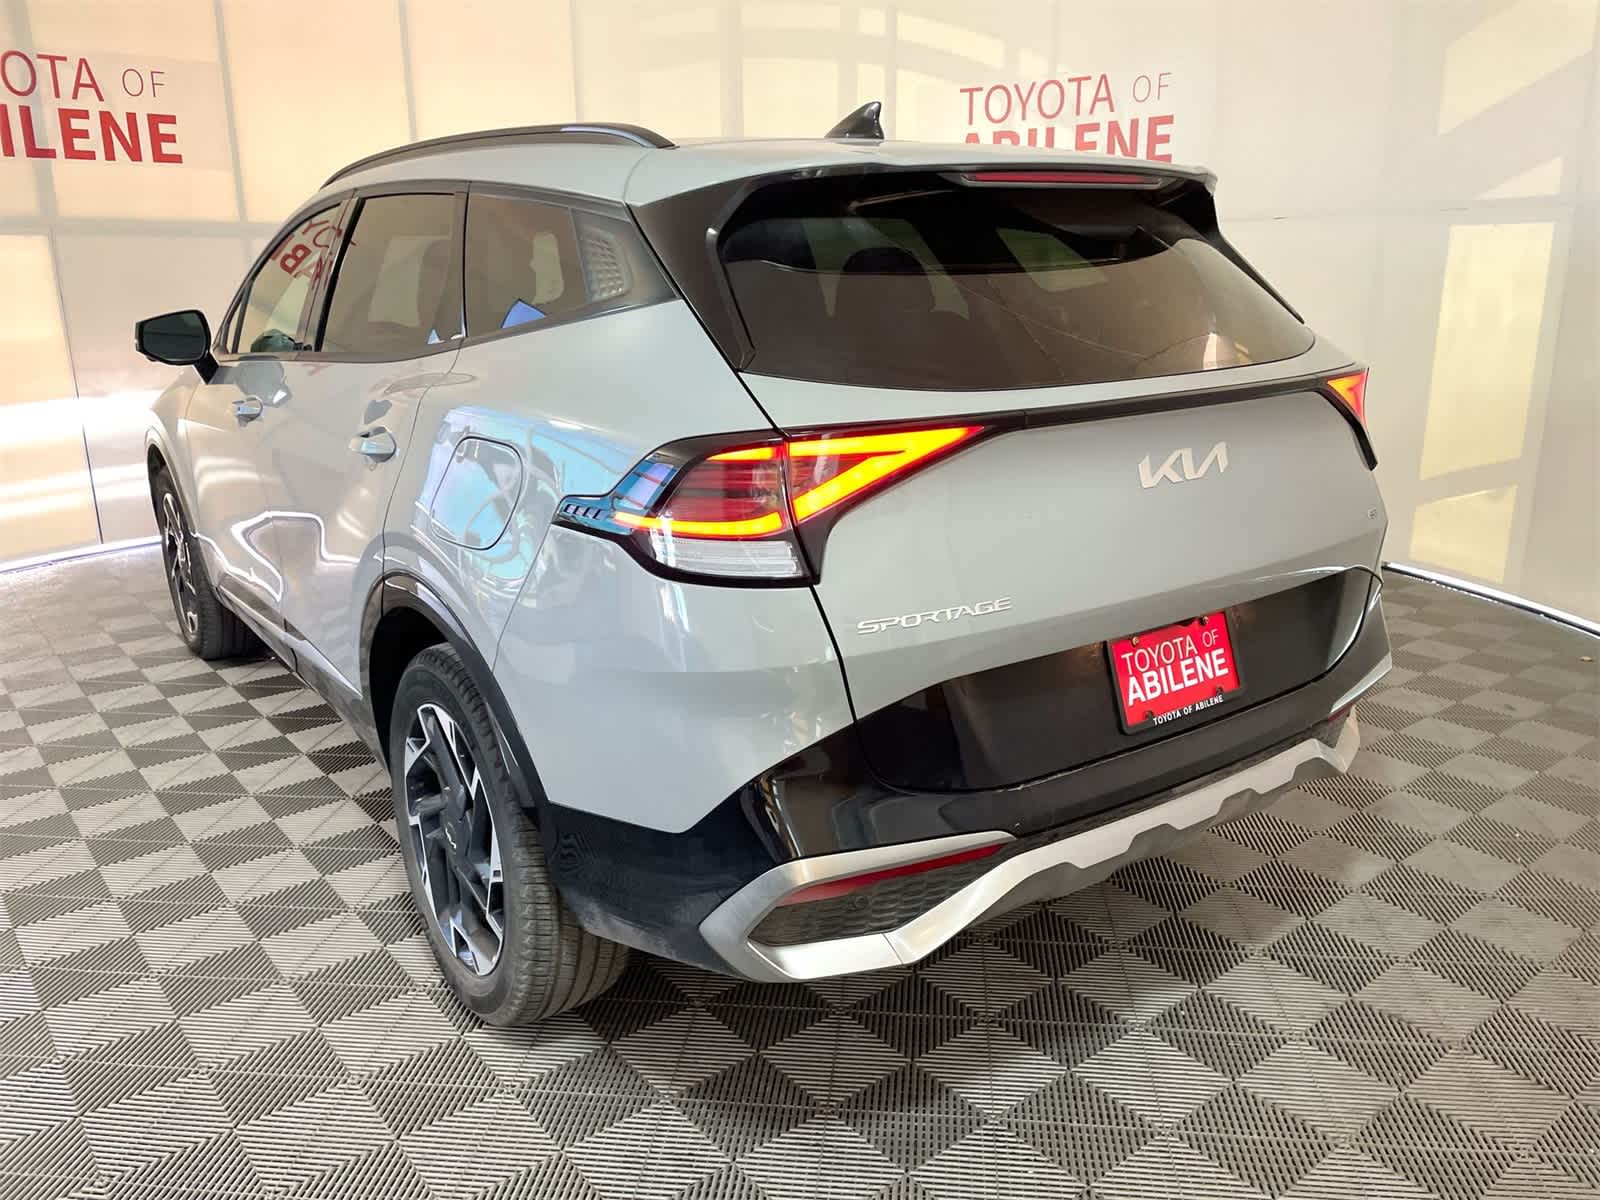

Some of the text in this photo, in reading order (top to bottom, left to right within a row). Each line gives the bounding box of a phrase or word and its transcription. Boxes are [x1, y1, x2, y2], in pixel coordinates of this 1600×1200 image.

[0, 50, 165, 102] OTA OF
[959, 72, 1173, 126] TOYOTA OF
[0, 103, 184, 164] ILENE
[965, 114, 1175, 163] LENE
[856, 596, 1012, 635] SPORTAGE
[1121, 629, 1219, 675] TOYOTA OF
[1128, 648, 1229, 706] ABILENE
[1153, 694, 1224, 726] TOYOTA OF ABILENE
